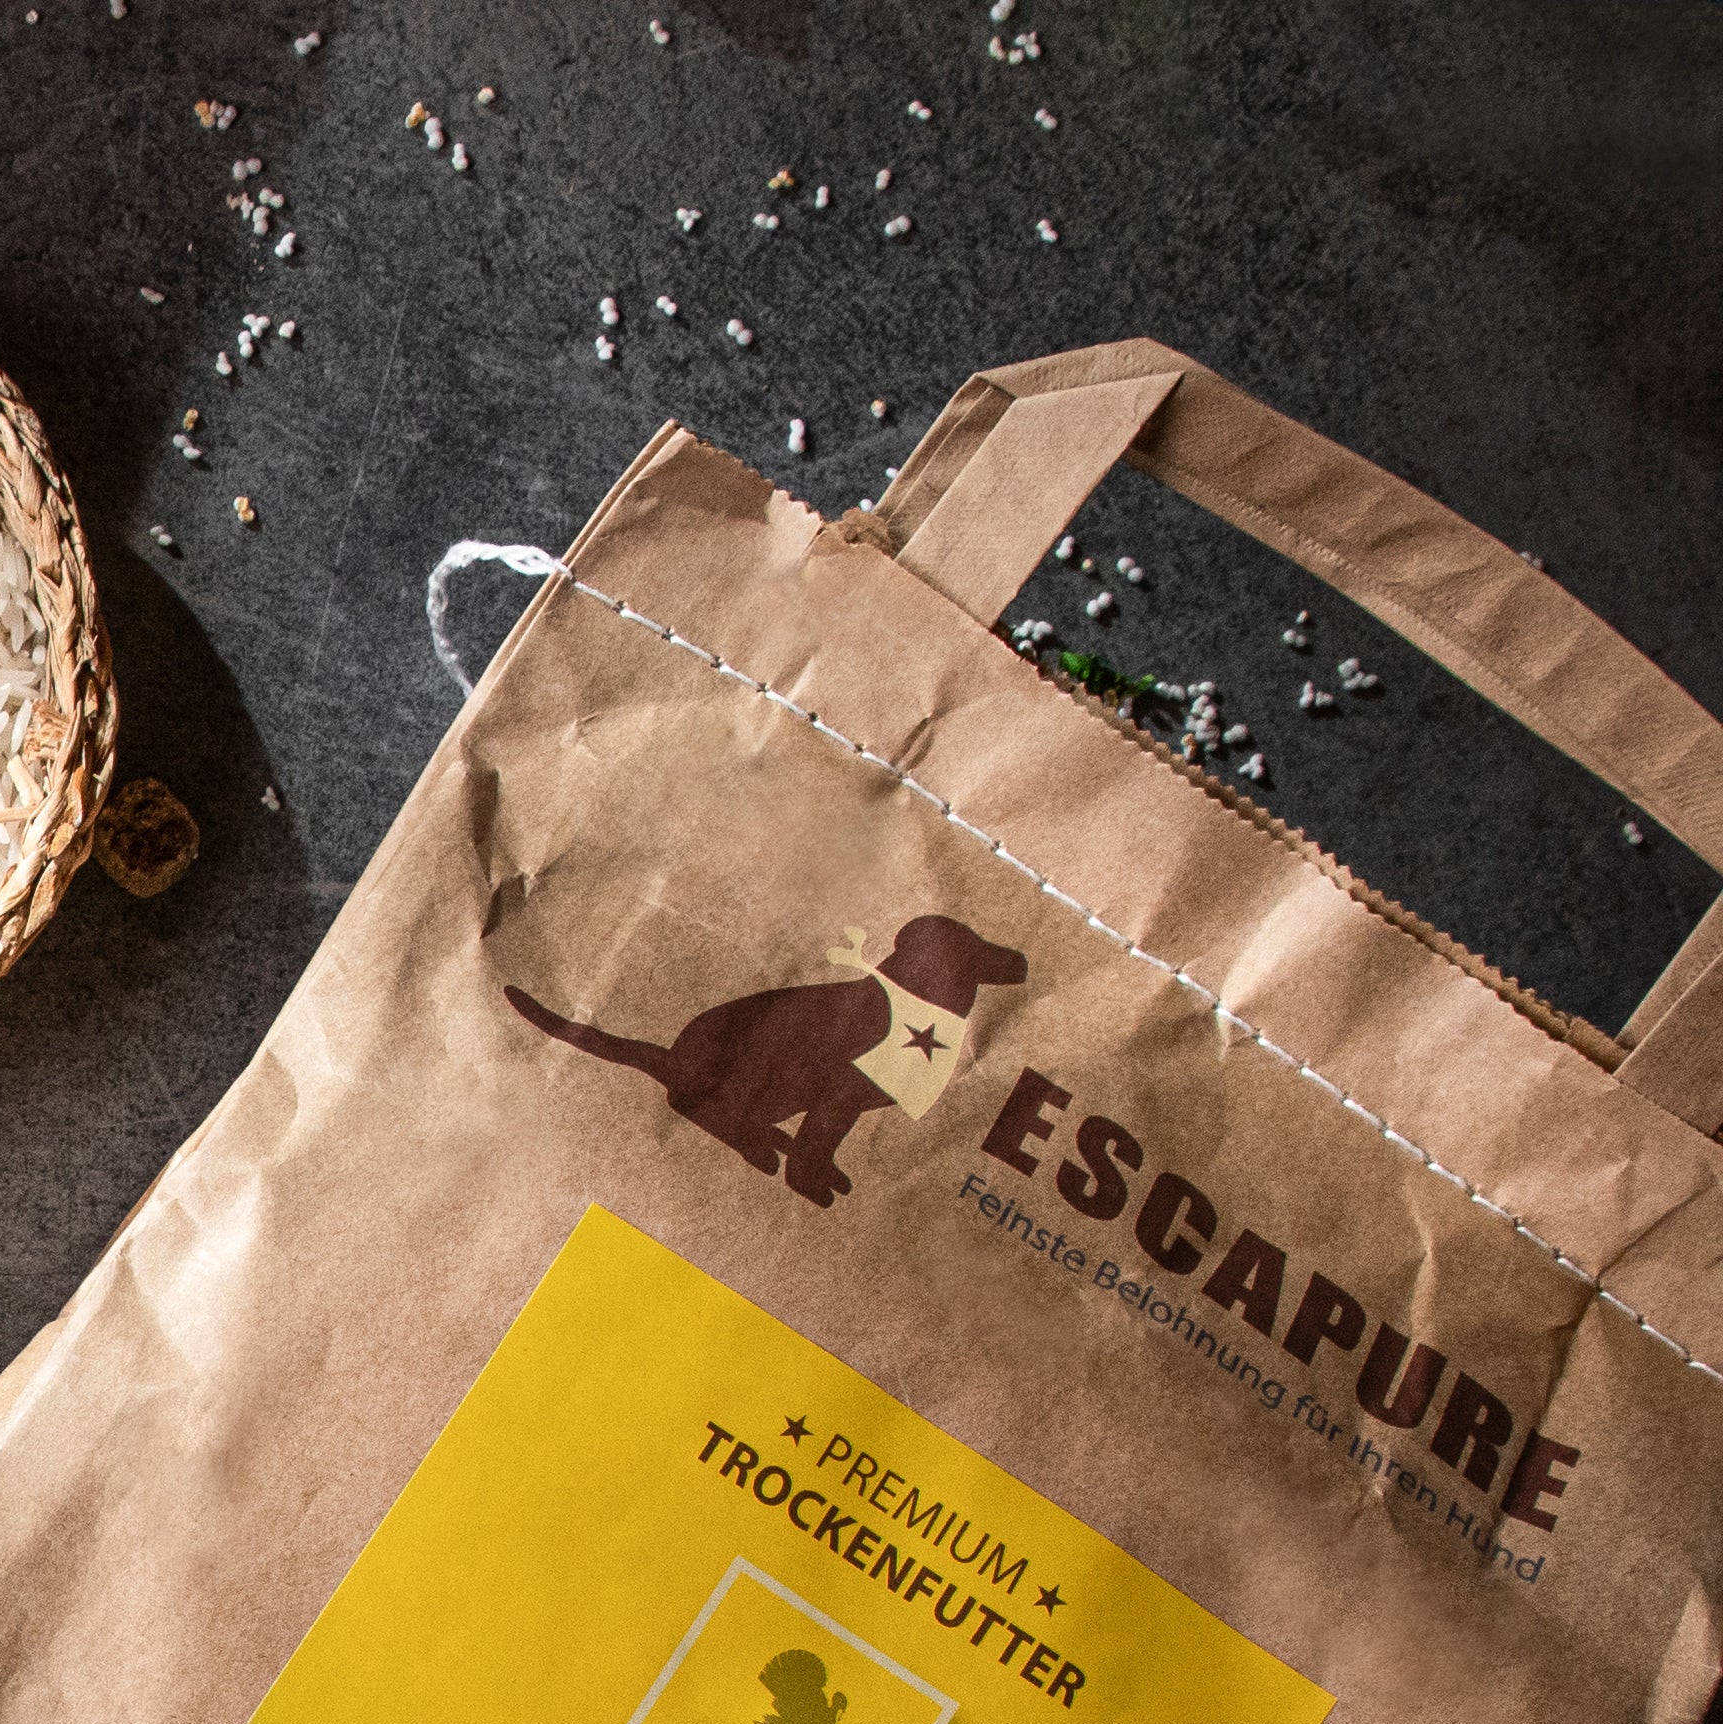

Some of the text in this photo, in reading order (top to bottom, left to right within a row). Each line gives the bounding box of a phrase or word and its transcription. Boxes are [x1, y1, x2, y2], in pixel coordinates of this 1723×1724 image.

[958, 1175, 1546, 1585] Feinste Belohnung für Ihren Hund
[980, 1066, 1581, 1533] ESCAPURE
[697, 1421, 1087, 1709] TROCKENFUTTER
[817, 1433, 1029, 1594] PREMIUM
